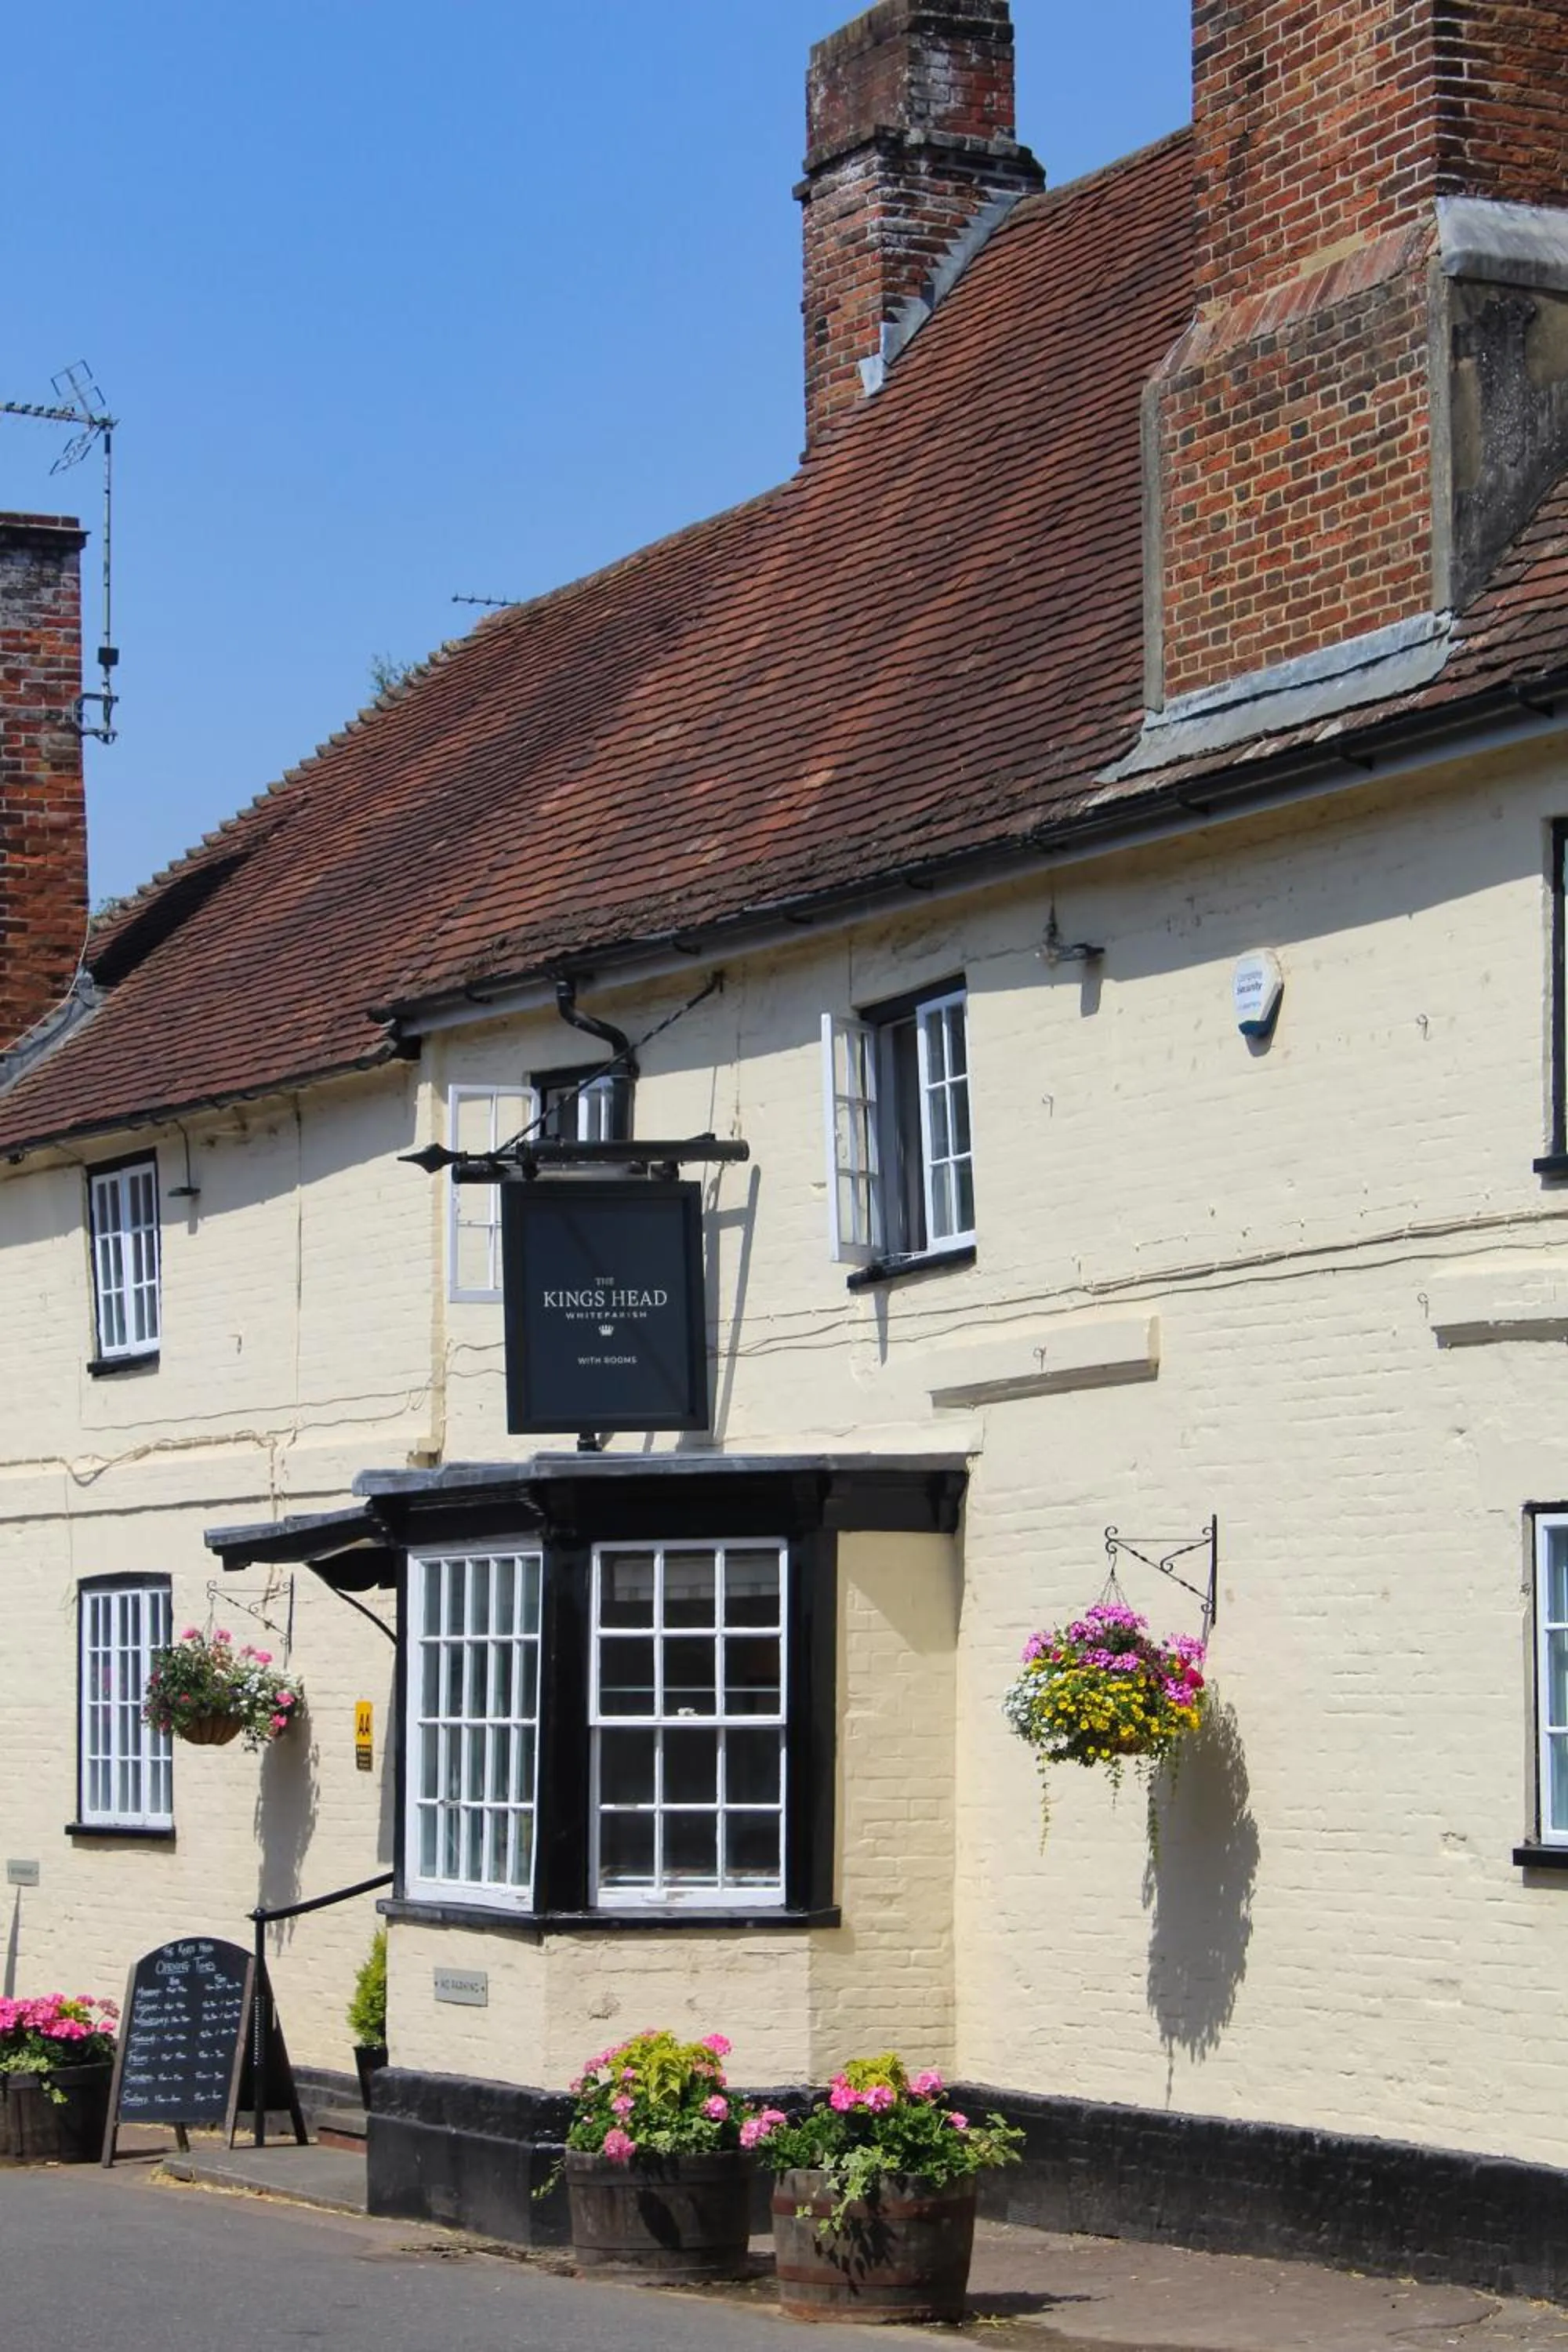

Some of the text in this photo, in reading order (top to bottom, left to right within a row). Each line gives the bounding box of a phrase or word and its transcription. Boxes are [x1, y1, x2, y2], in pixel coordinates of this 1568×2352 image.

[594, 1277, 615, 1287] THE
[543, 1290, 668, 1308] KINGS HEAD
[565, 1311, 648, 1320] WHITEPARISH
[577, 1356, 602, 1365] WITH
